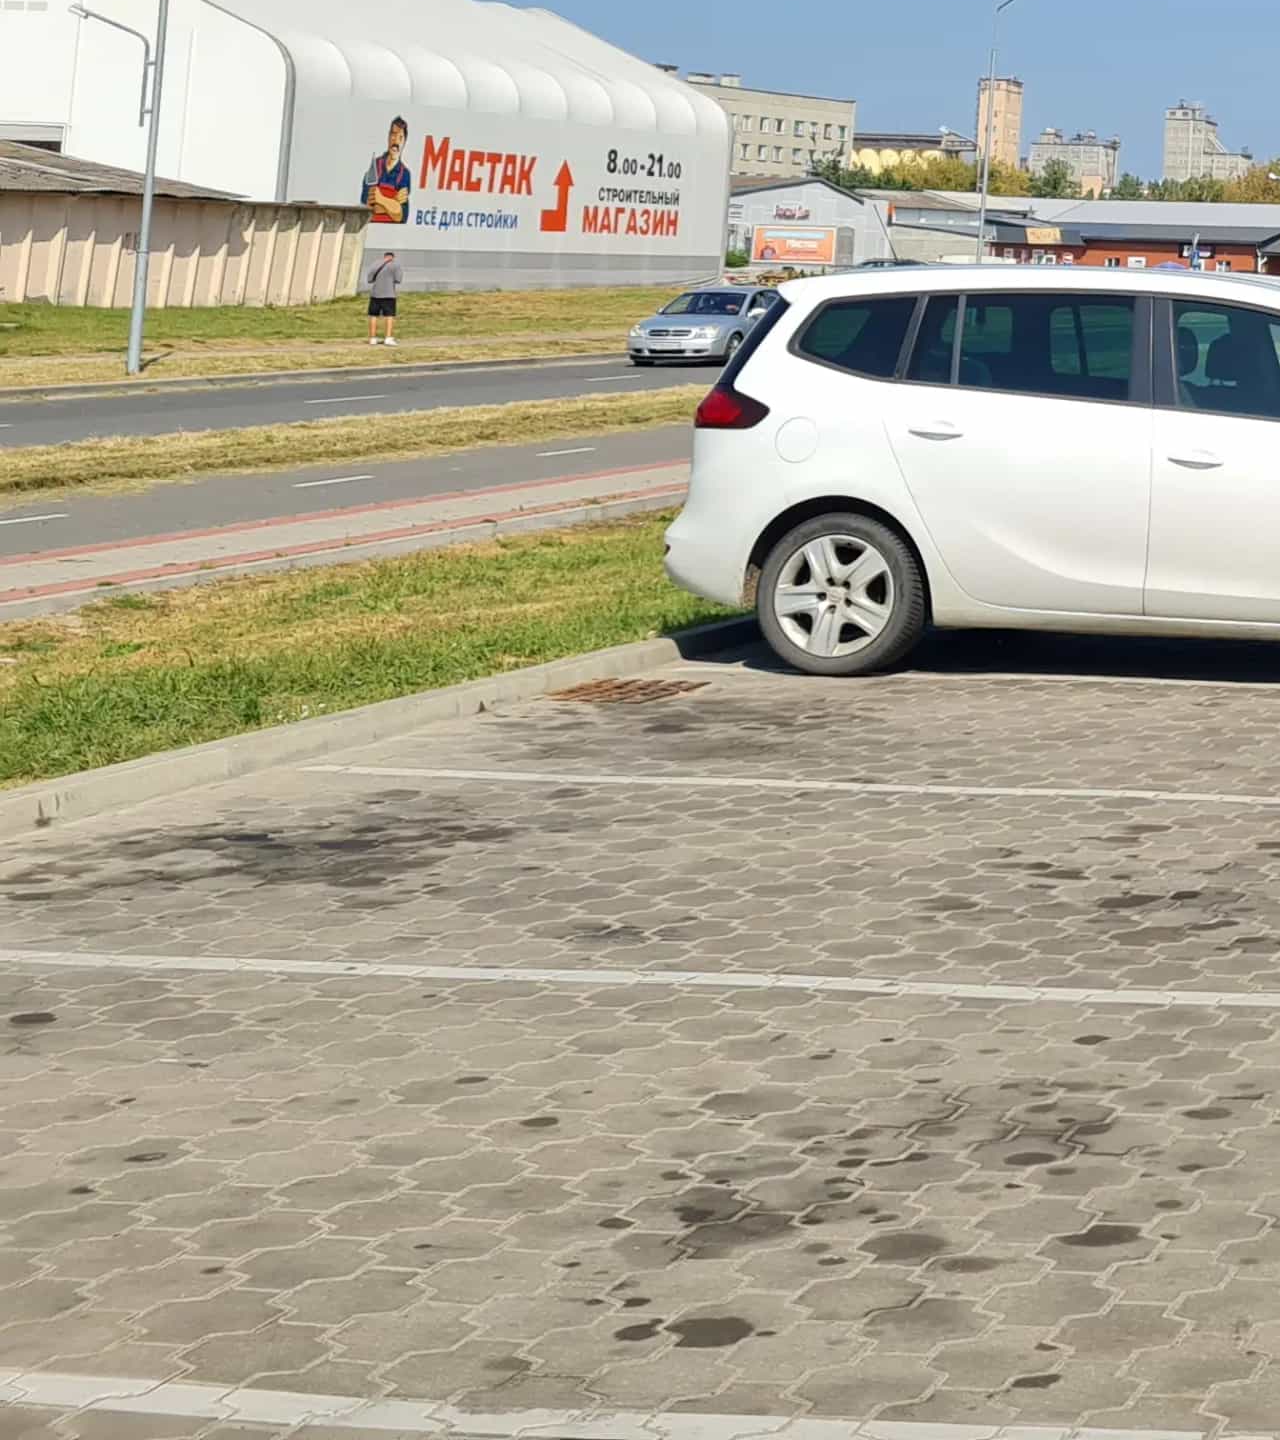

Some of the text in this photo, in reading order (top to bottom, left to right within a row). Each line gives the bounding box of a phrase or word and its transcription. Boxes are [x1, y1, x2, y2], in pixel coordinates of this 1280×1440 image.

[598, 187, 680, 207] СТРОИТЕЛЬНЫЙ
[416, 206, 518, 231] ВСЁ ДЛЯ СТРОЙКИ
[582, 205, 679, 236] МАГАЗИН
